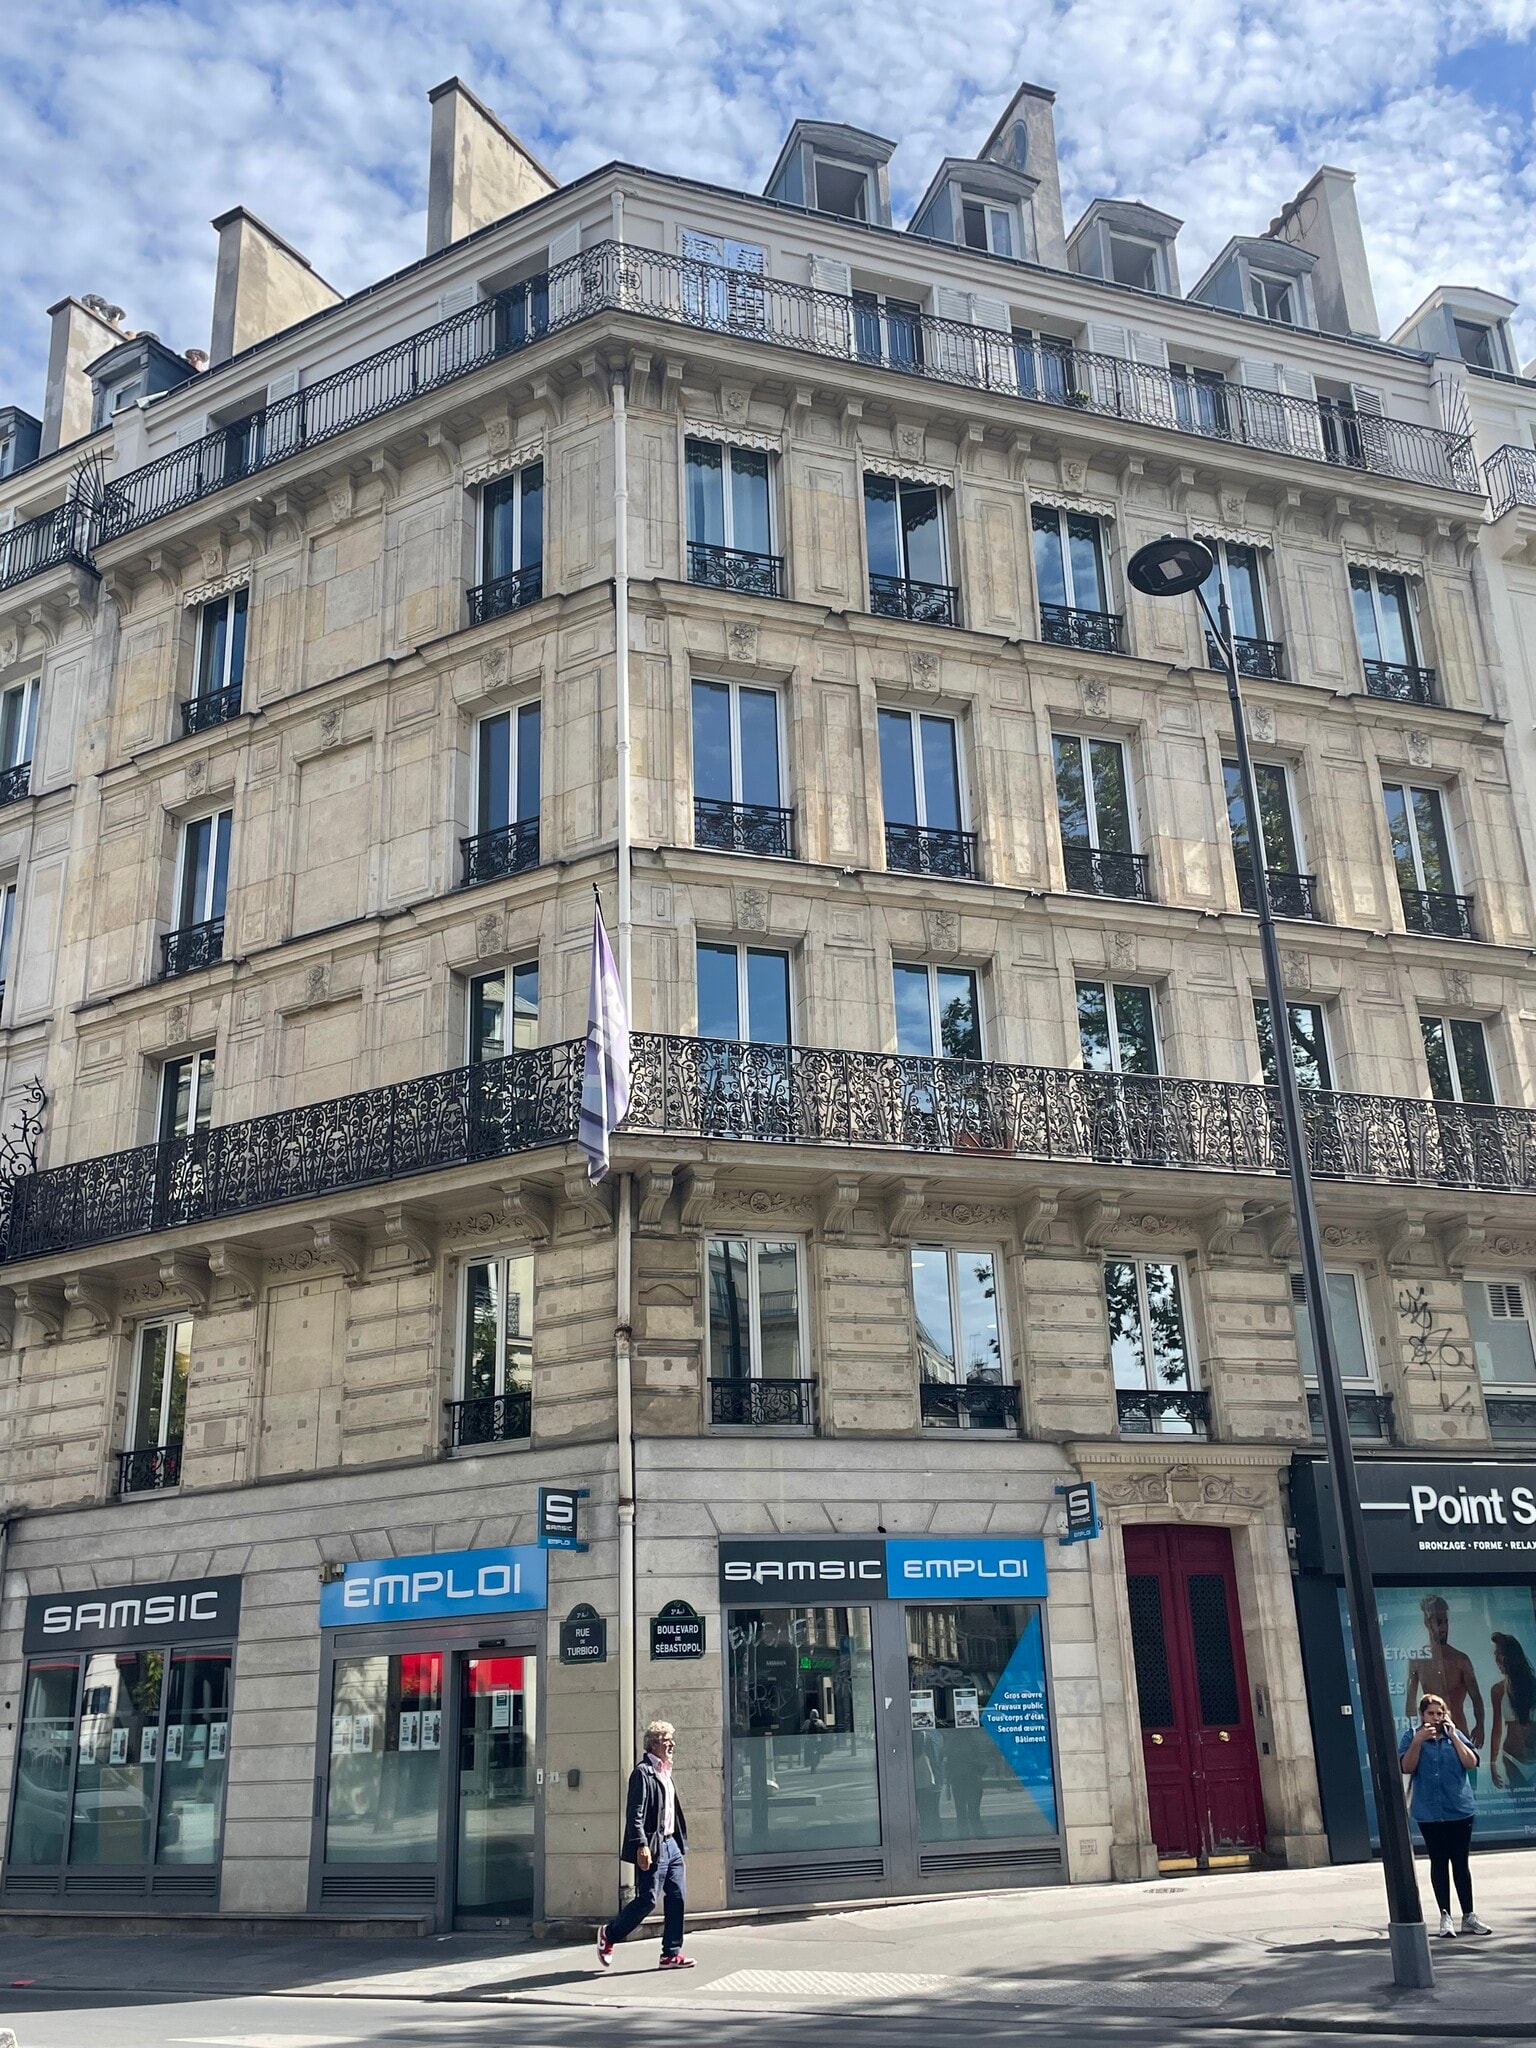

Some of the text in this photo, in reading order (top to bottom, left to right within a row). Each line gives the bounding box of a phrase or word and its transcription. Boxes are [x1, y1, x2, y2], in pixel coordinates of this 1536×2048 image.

[545, 1494, 573, 1523] S
[1068, 1489, 1090, 1517] S
[1411, 1485, 1507, 1525] Point
[1419, 1541, 1466, 1550] BRONZAGE
[1473, 1541, 1503, 1550] FORME
[724, 1559, 1028, 1581] SAMSIC EMPLOI
[343, 1563, 521, 1608] EMPLOI
[42, 1591, 218, 1634] SAMSIC
[575, 1627, 591, 1637] RUE
[657, 1624, 699, 1635] BOULEVARD
[566, 1645, 599, 1656] TURBIGO
[655, 1641, 701, 1653] SÉBASTOPOL
[1004, 1691, 1020, 1699] Gros
[994, 1702, 1044, 1711] Travaux public
[987, 1714, 1004, 1722] Tous
[1024, 1713, 1045, 1721] d'état
[997, 1725, 1022, 1733] Second
[1015, 1736, 1046, 1744] Bâtiment
